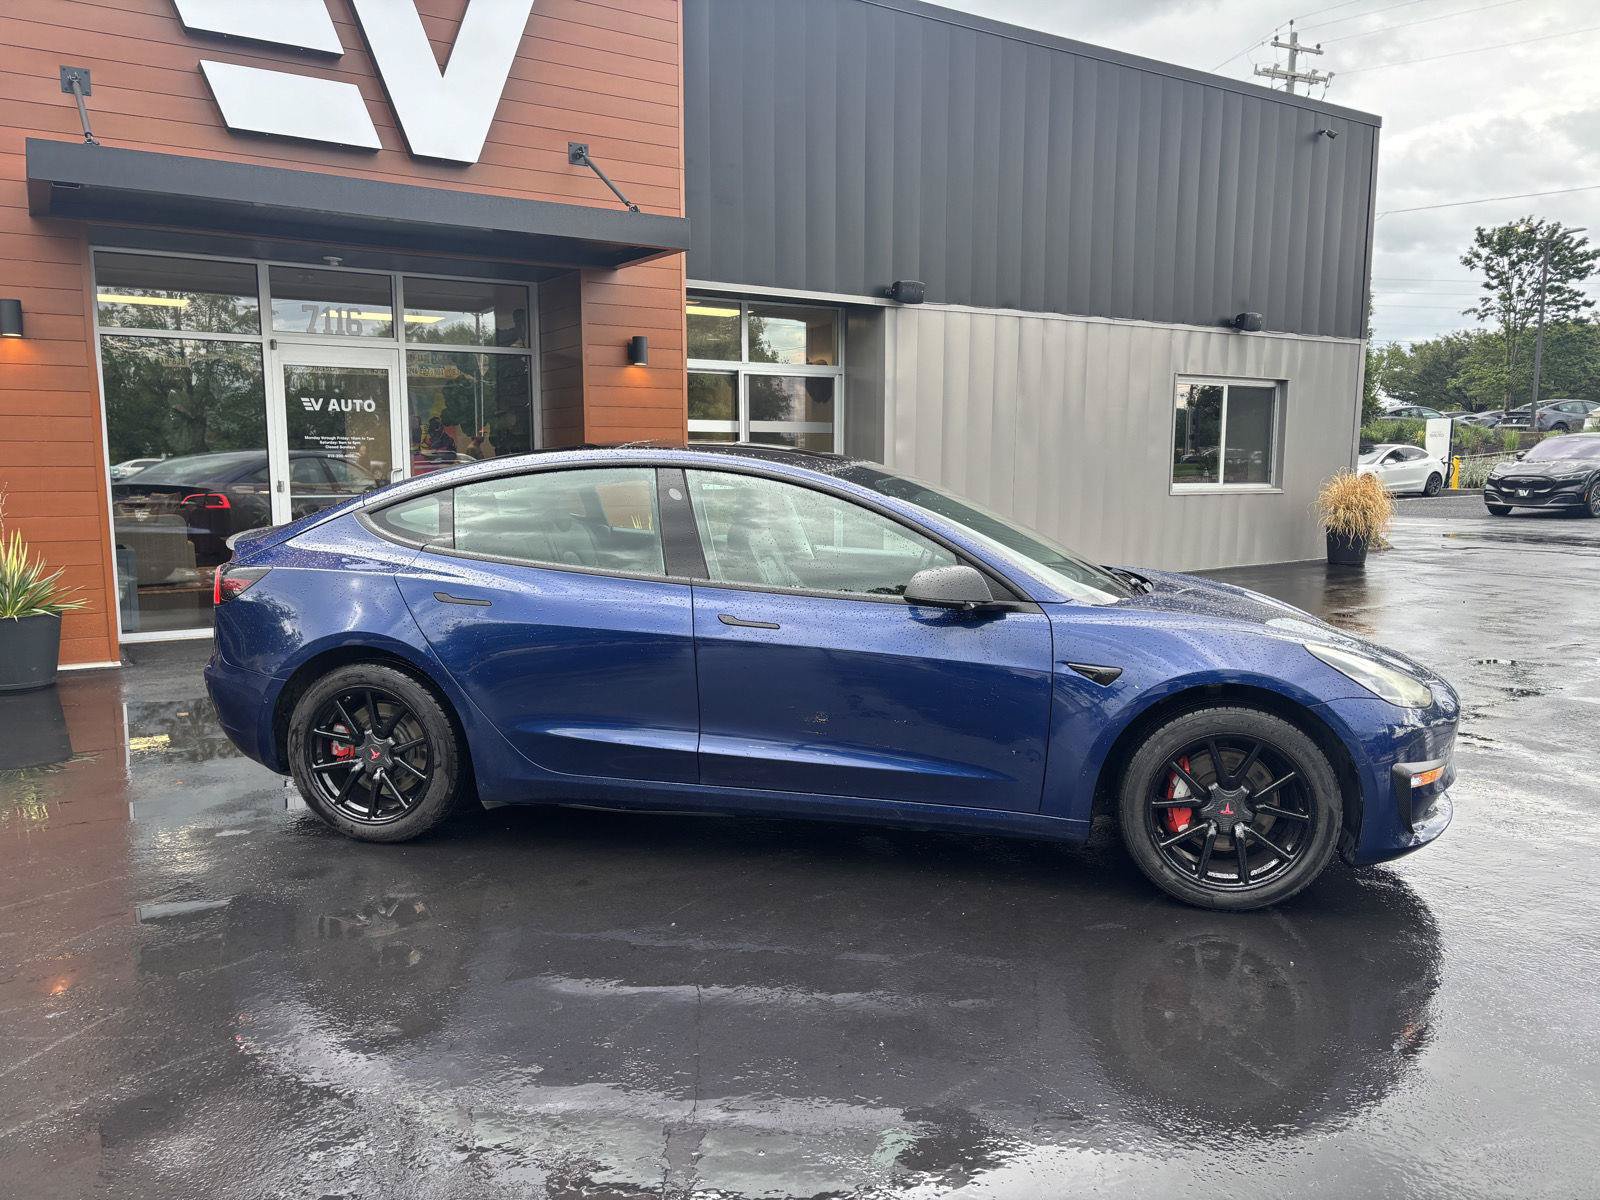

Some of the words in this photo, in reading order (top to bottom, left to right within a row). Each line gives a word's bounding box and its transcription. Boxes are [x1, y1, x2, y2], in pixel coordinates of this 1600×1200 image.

[301, 304, 363, 336] 7116
[301, 397, 324, 411] EV
[328, 398, 376, 412] AUTO
